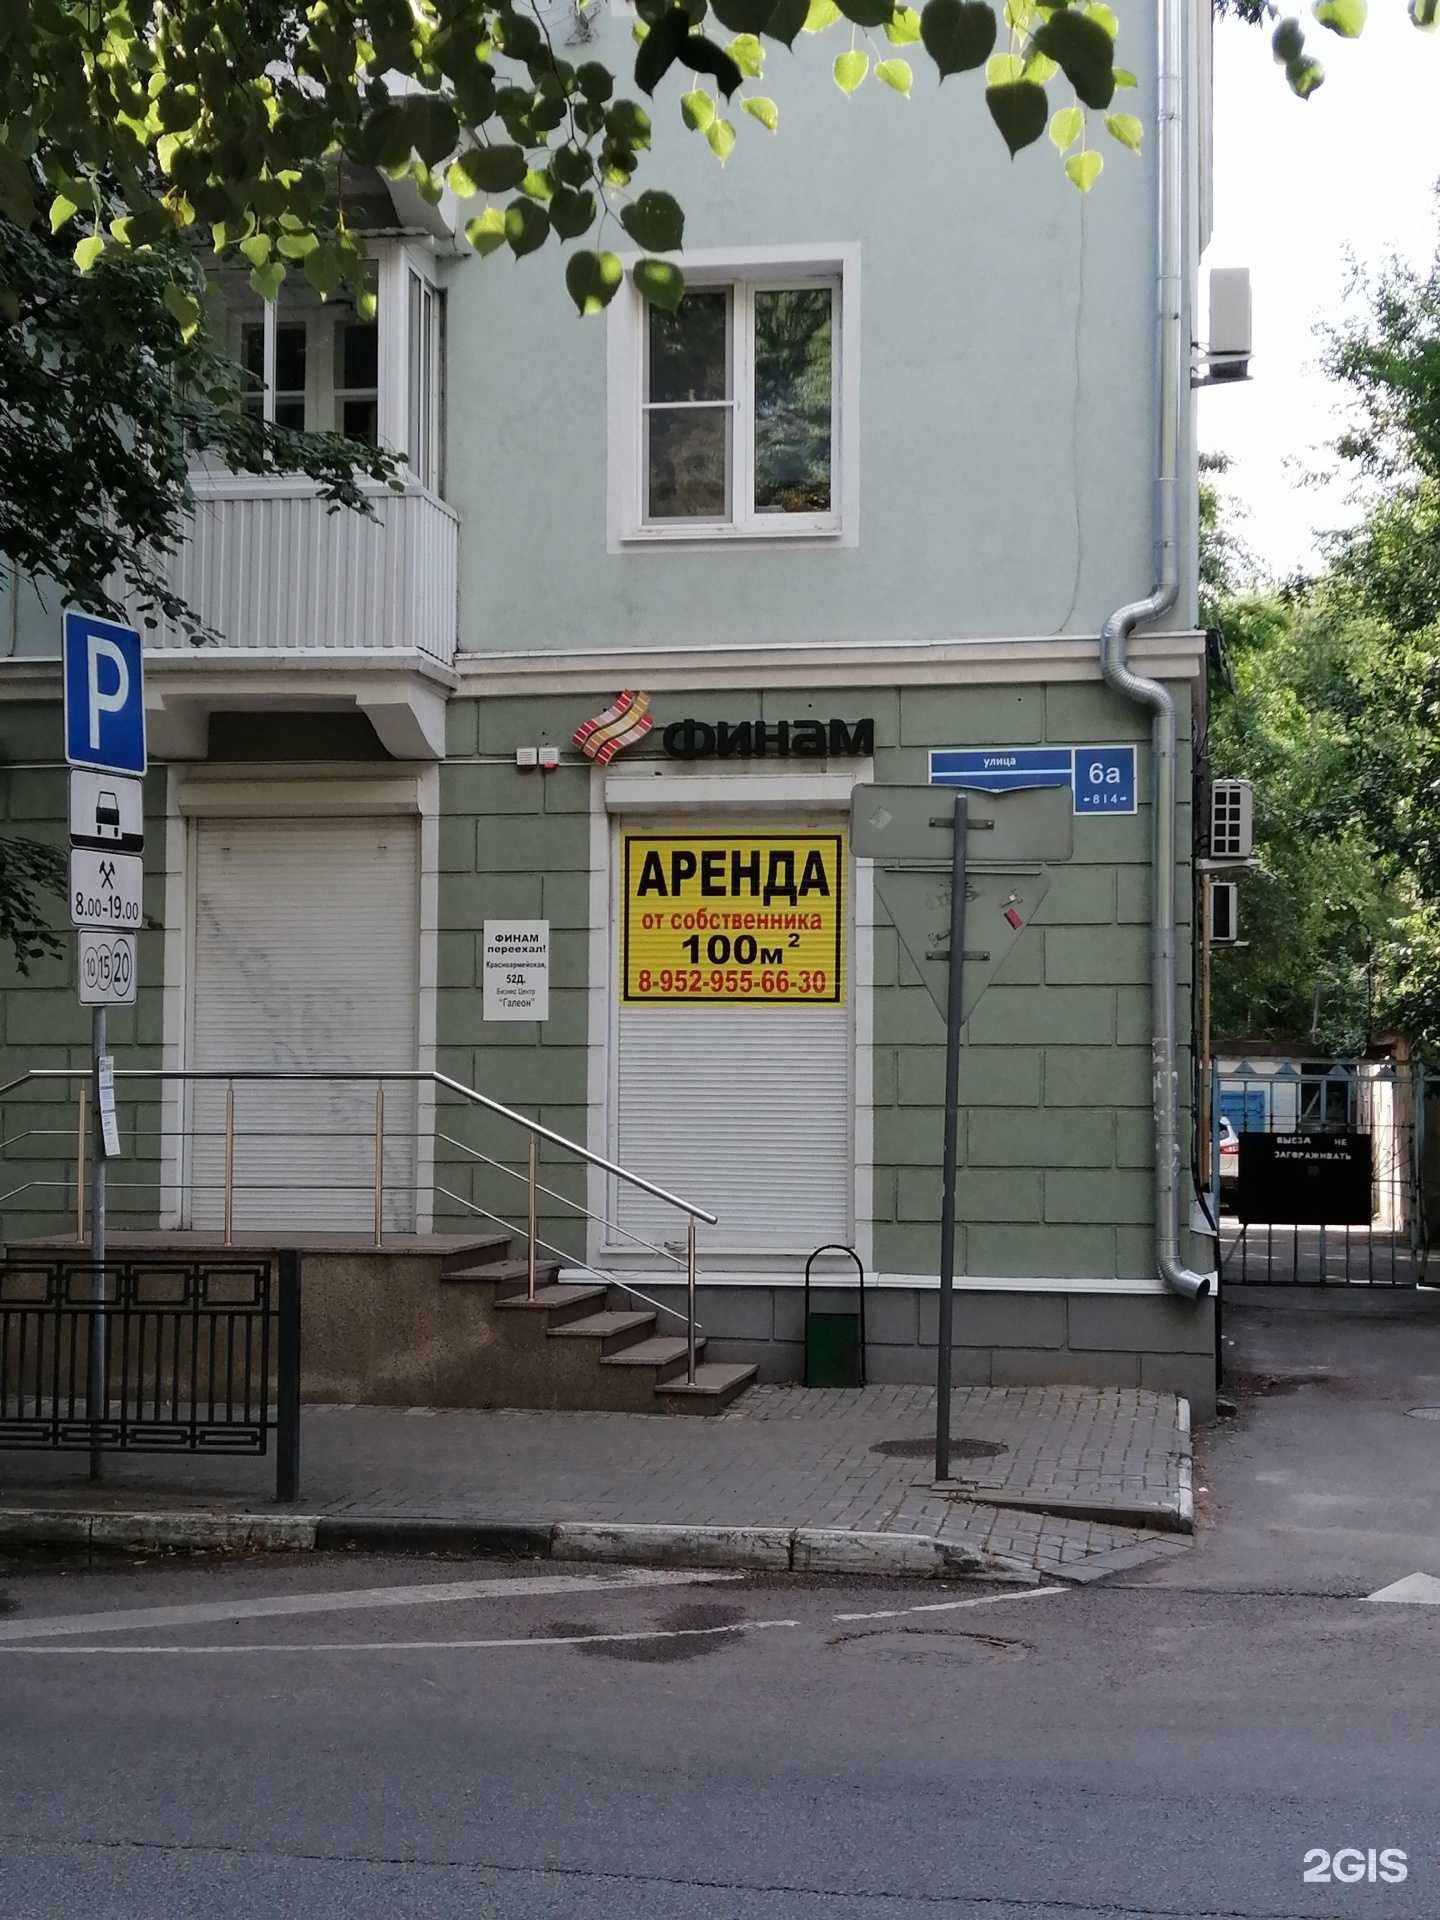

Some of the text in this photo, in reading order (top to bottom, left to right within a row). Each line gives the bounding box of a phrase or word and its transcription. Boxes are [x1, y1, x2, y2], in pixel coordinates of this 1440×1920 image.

[87, 634, 129, 749] P
[984, 757, 1016, 768] улица
[1089, 763, 1120, 784] 6а
[636, 850, 830, 907] АРЕНДА
[75, 892, 139, 920] 8.00-19.00
[642, 907, 822, 930] от собственника
[487, 945, 546, 955] переехал!
[494, 934, 539, 943] ФИНАМ
[86, 951, 130, 983] 10 15 20
[638, 969, 827, 993] 8-952-955-66-30
[1334, 1138, 1348, 1146] НЕ
